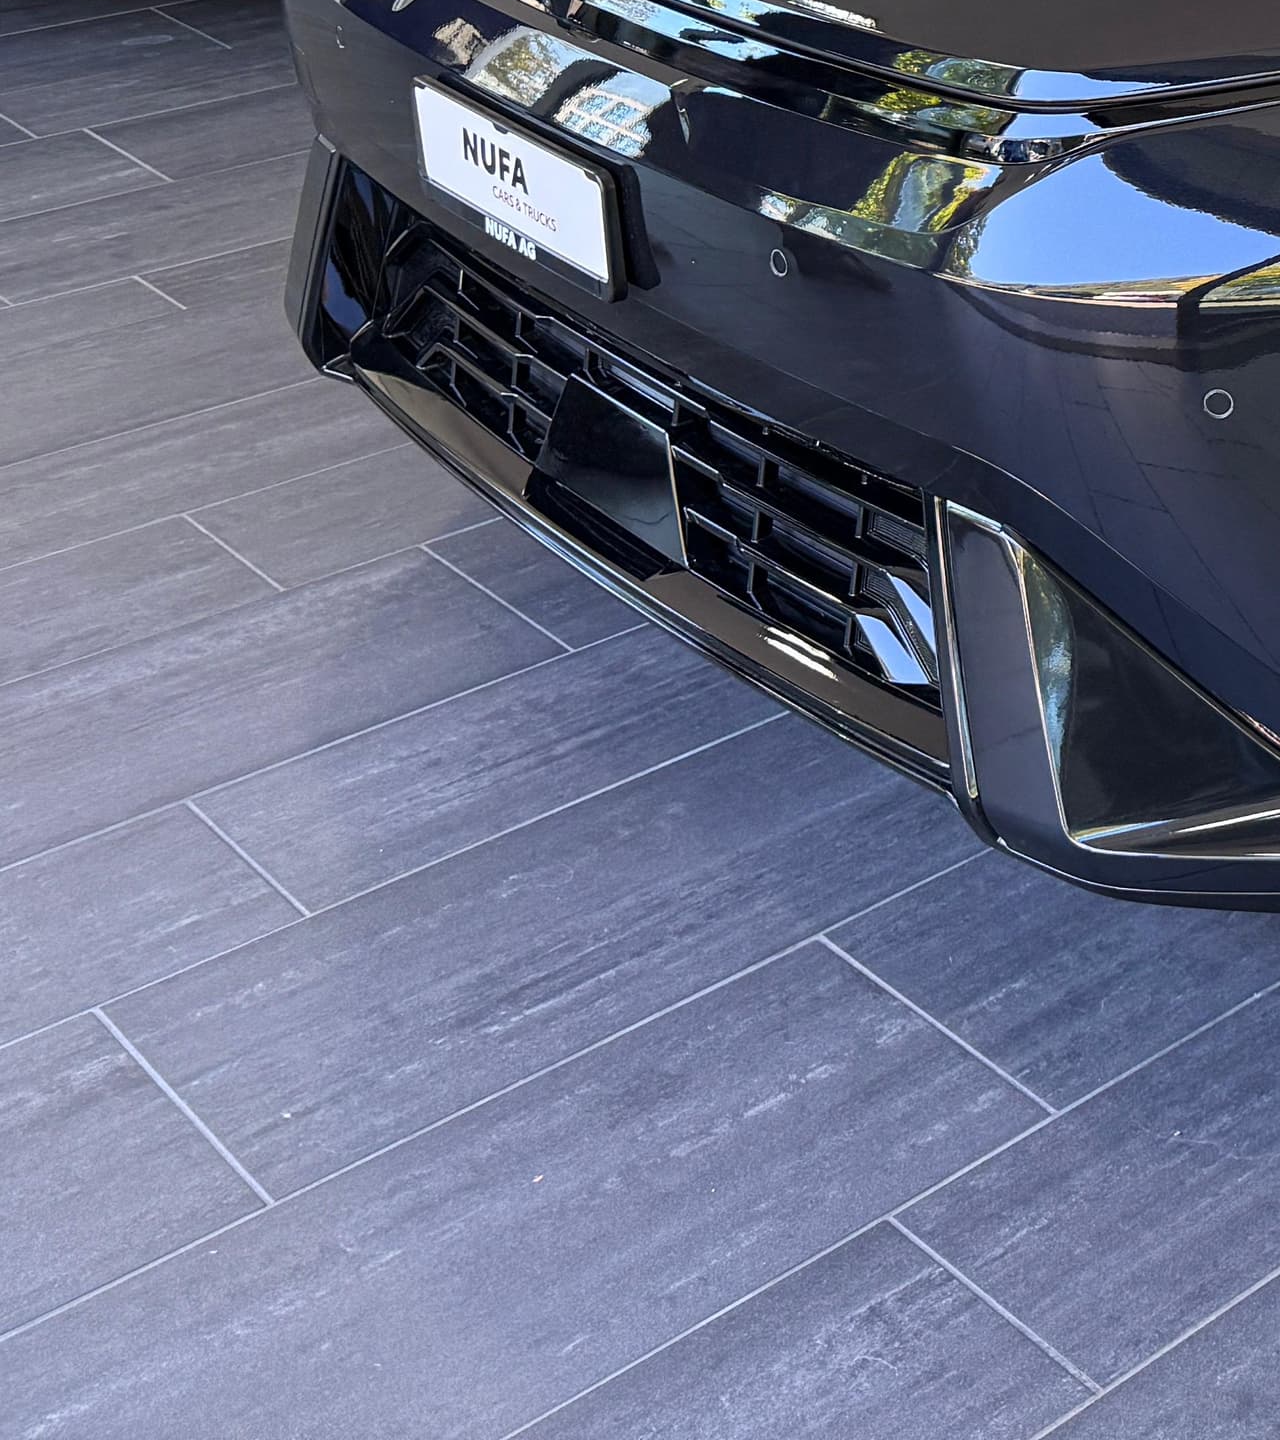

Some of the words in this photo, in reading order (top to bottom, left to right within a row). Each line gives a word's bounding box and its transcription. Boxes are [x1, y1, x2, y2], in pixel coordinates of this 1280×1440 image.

[462, 127, 529, 196] NUFA
[492, 185, 515, 208] CARS
[514, 197, 522, 212] &
[522, 202, 557, 232] TRUCKS
[485, 216, 517, 250] NUFA
[519, 237, 537, 260] AG
